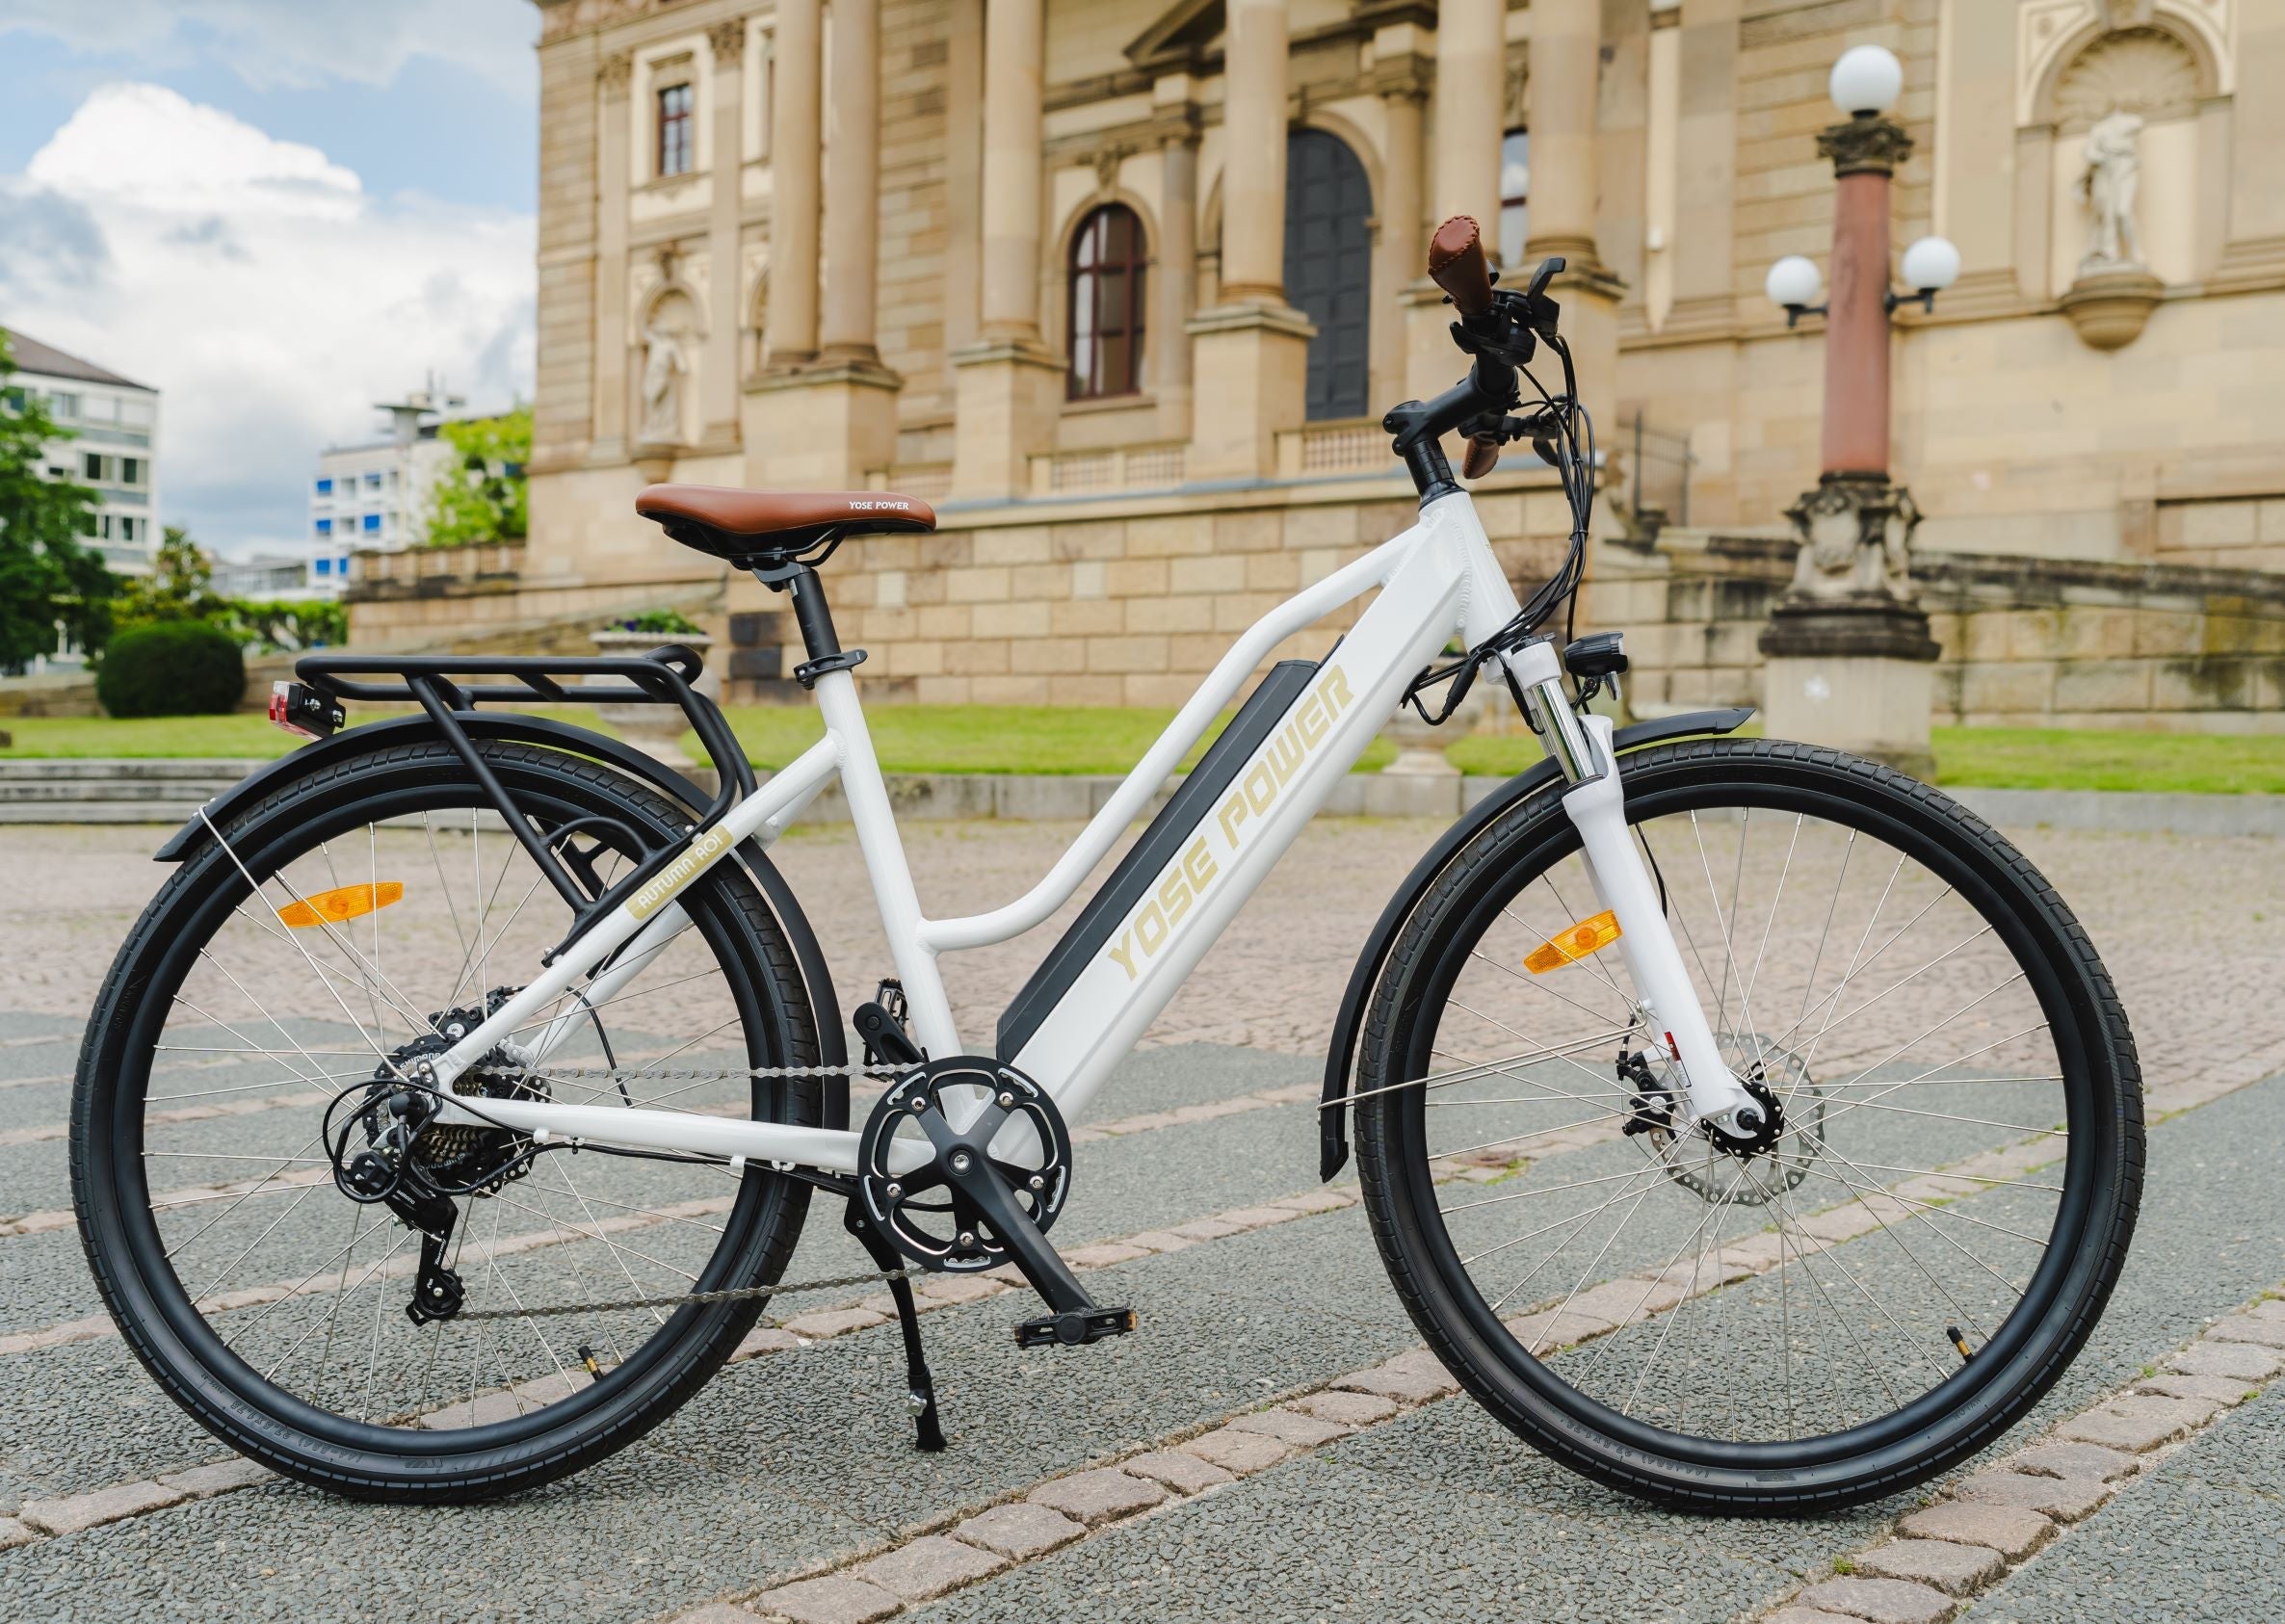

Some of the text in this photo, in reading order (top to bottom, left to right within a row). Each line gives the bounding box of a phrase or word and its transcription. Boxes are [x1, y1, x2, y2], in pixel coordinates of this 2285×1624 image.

[849, 501, 909, 510] YOSE POWER
[1108, 664, 1354, 982] YOSE POWER
[638, 858, 696, 908] AUTUMN
